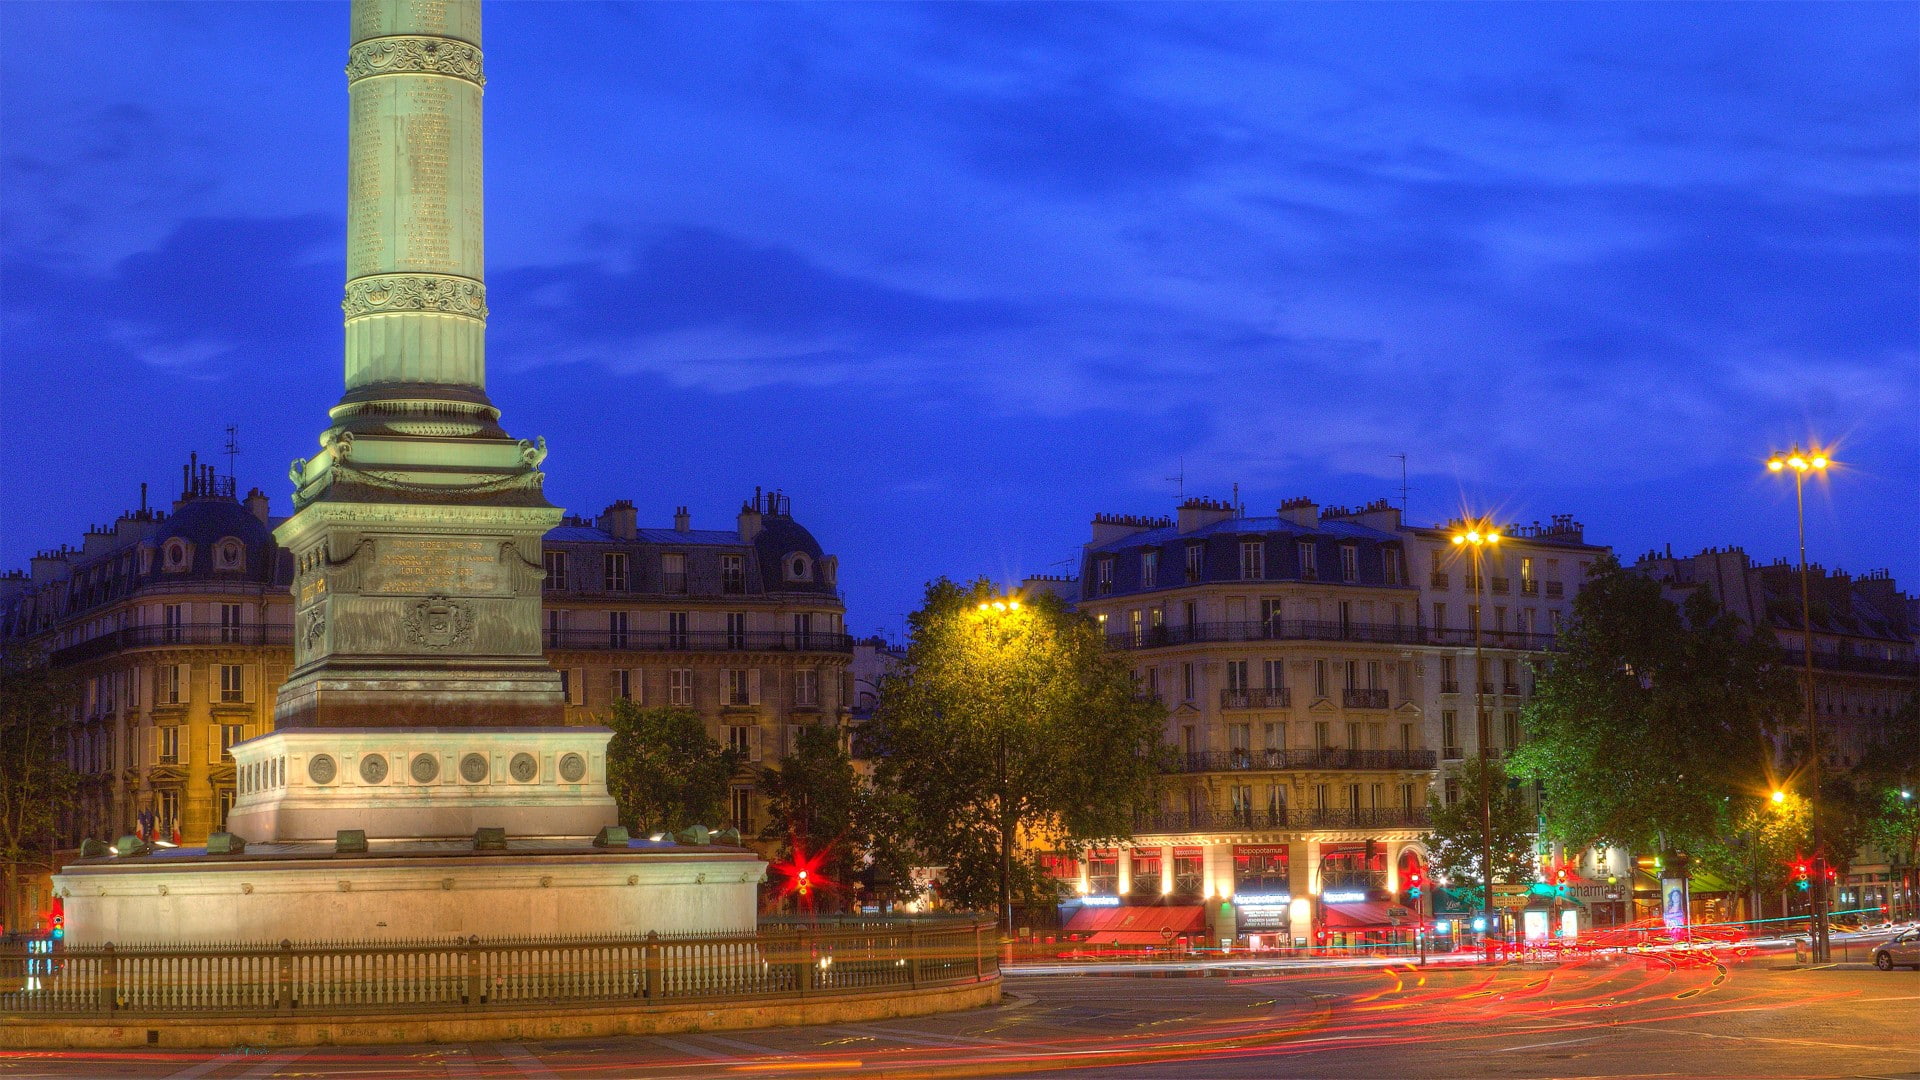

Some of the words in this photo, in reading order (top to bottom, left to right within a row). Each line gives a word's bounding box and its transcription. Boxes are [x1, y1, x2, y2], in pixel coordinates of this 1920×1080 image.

[1175, 849, 1203, 857] hippopotamus
[1238, 847, 1283, 855] hippopotamus
[1234, 894, 1290, 905] hippopotamus
